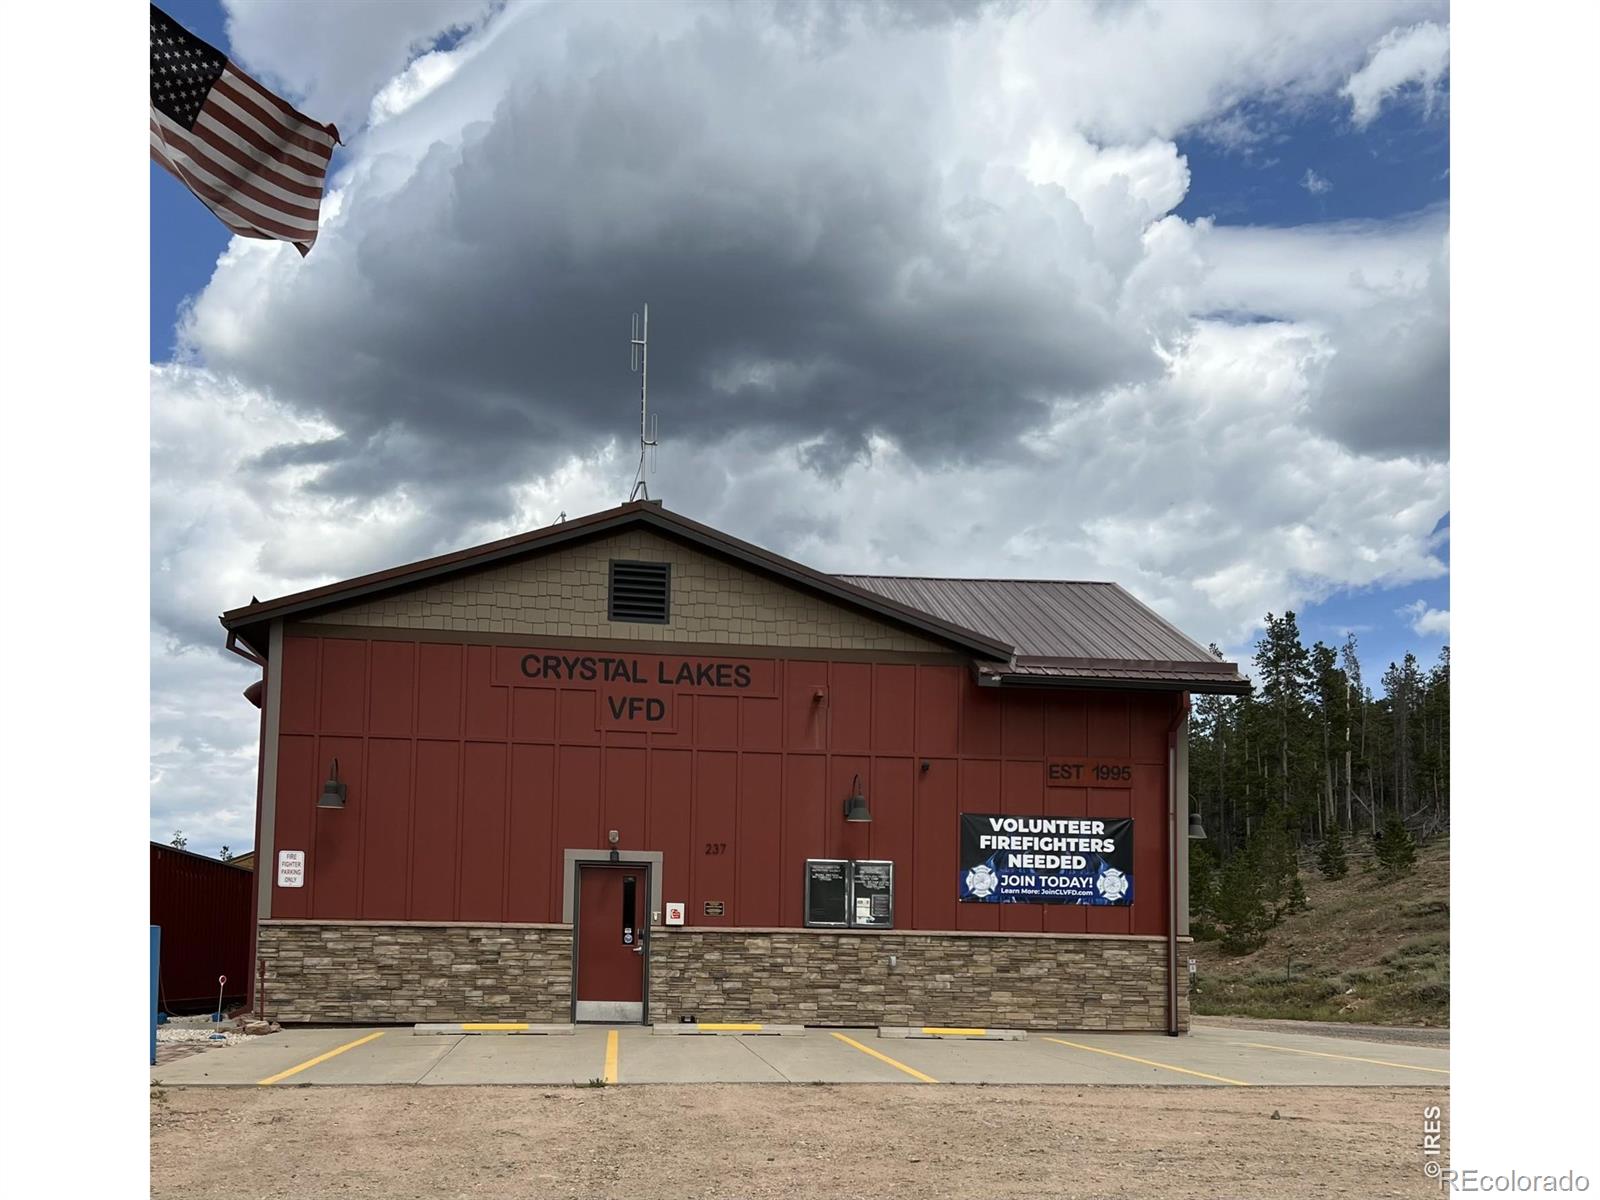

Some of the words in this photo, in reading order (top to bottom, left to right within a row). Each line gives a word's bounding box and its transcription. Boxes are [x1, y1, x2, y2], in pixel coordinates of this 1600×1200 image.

[520, 654, 648, 684] CRYSTAL
[658, 661, 752, 687] LAKES
[608, 696, 665, 721] VFD
[1048, 764, 1084, 779] EST
[1092, 764, 1132, 781] 1995
[989, 817, 1105, 835] VOLUNTEER
[705, 843, 727, 855] 237
[980, 835, 1115, 853] FIREFIGHTERS
[1008, 854, 1087, 870] NEEDED
[1000, 875, 1036, 887] JOIN
[1039, 876, 1093, 888] TODAY!
[1000, 887, 1020, 895] Learn
[1041, 888, 1093, 896] JoinCLVFD.com
